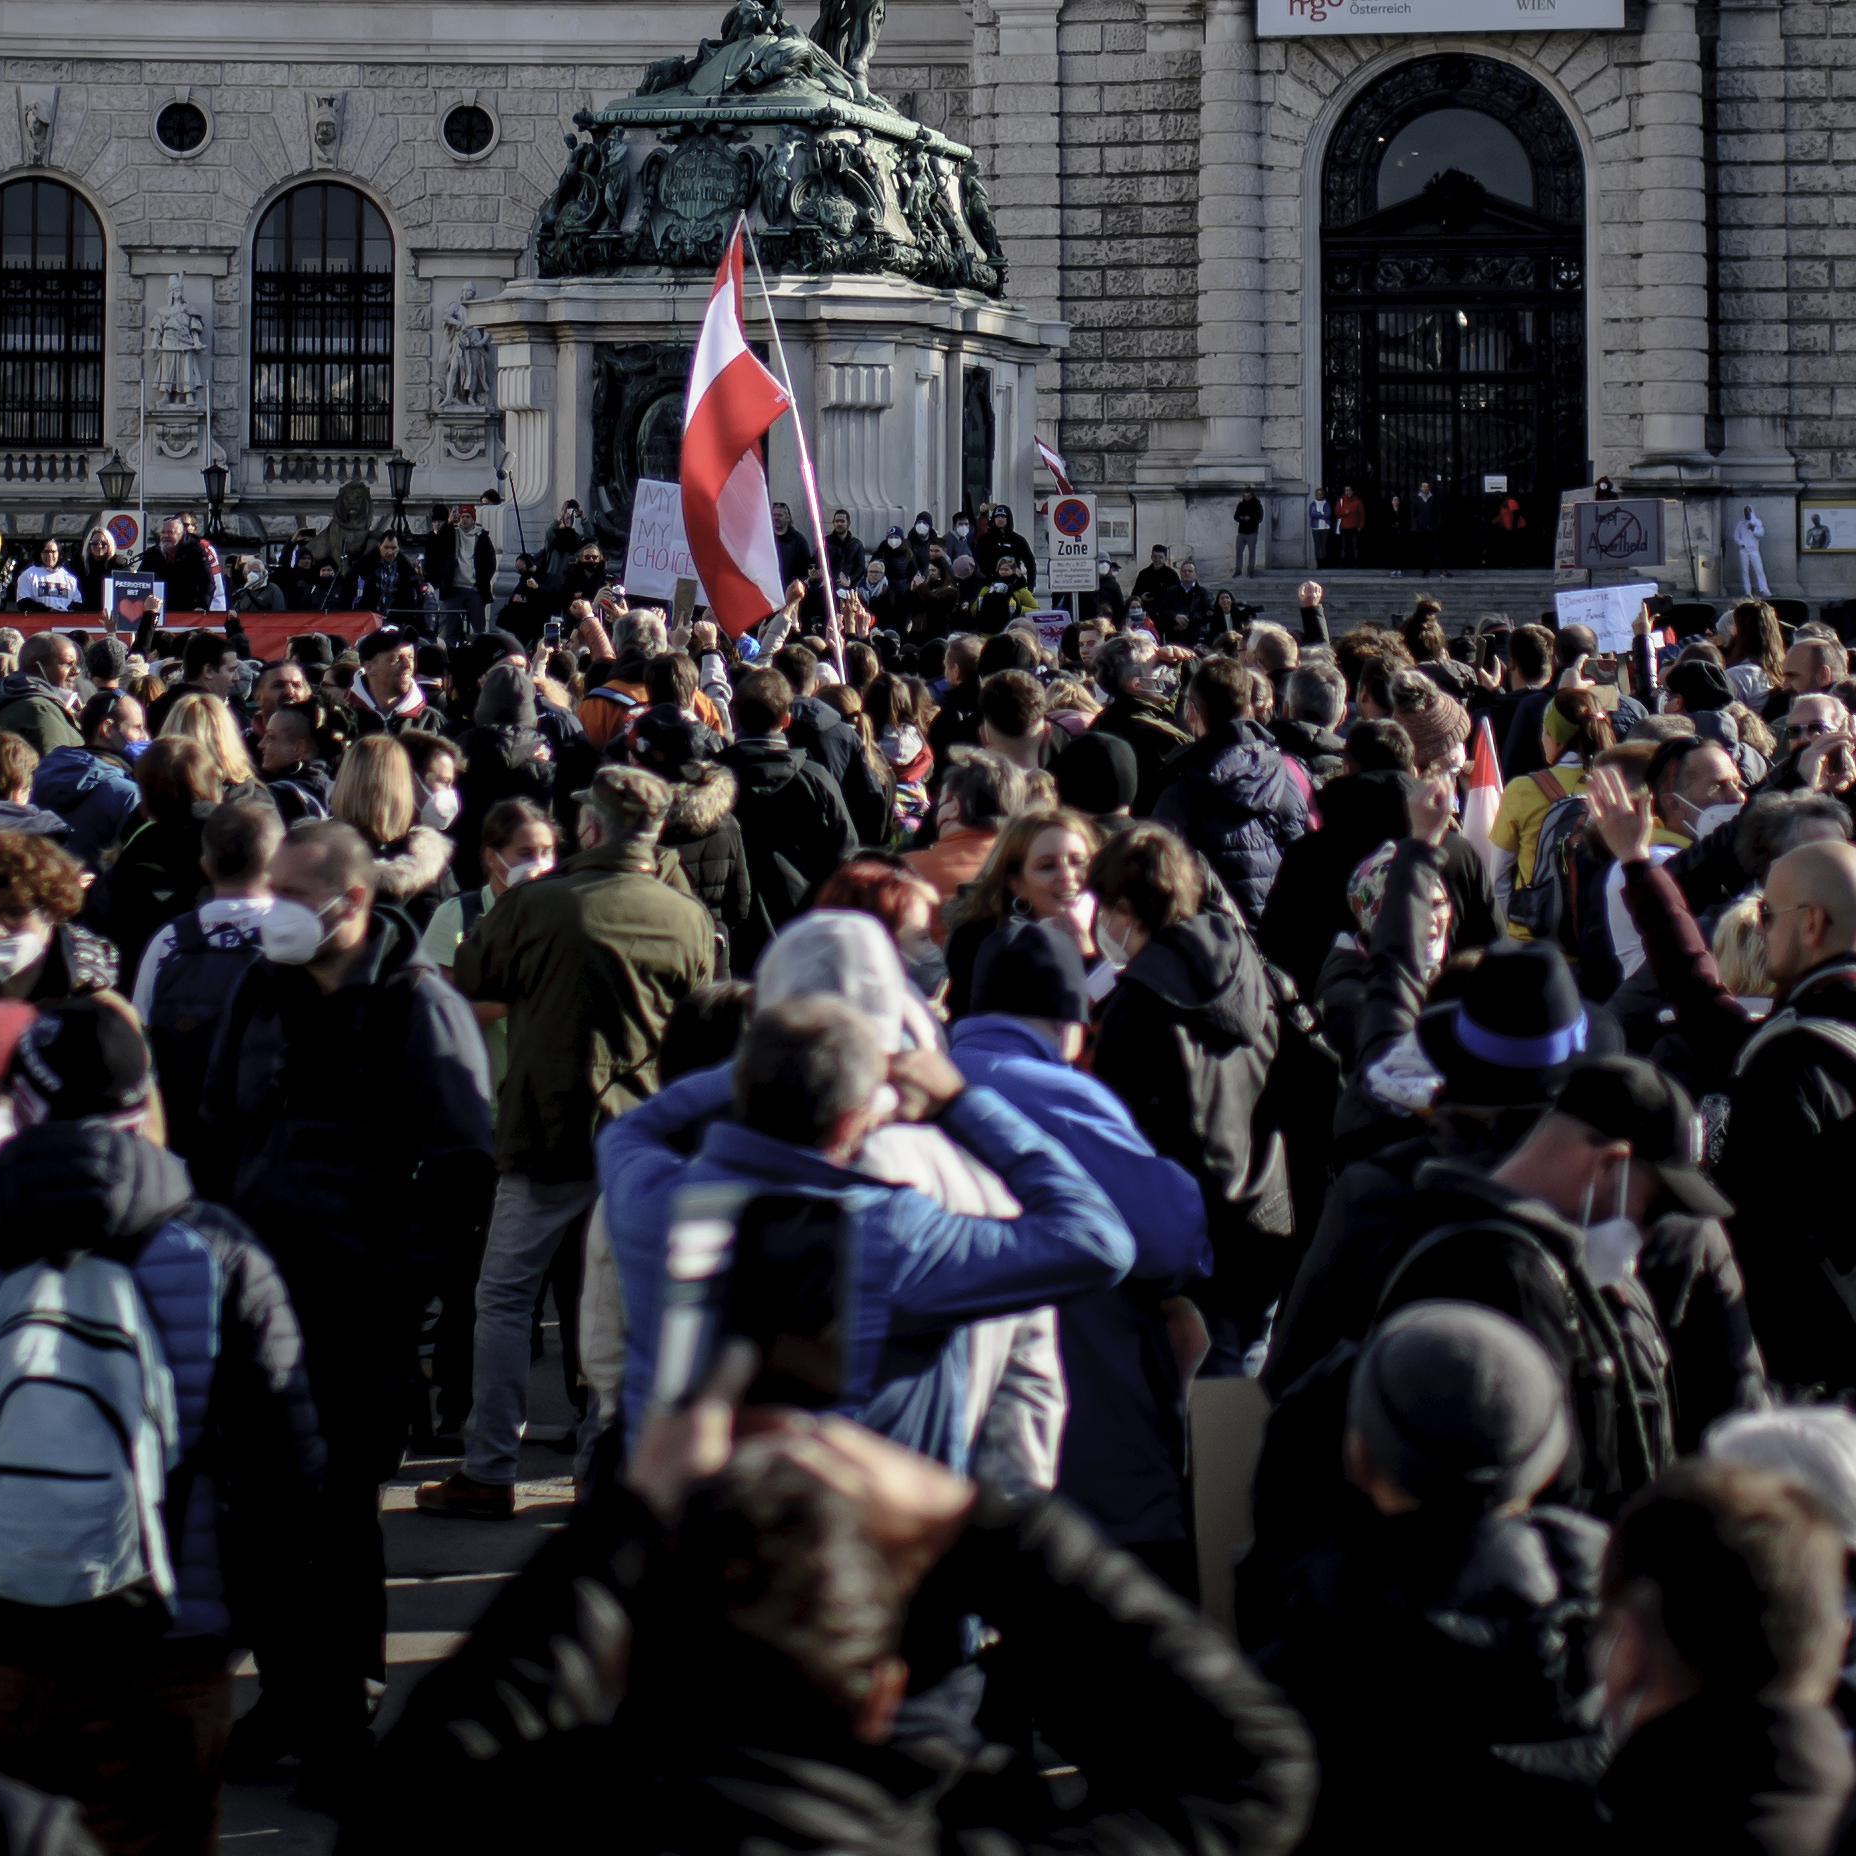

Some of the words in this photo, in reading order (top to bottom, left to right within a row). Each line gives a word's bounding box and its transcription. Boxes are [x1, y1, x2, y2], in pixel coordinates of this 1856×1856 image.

[1349, 1, 1412, 15] Österreich
[643, 485, 678, 513] MY
[638, 519, 671, 546] MY
[1057, 540, 1088, 556] Zone
